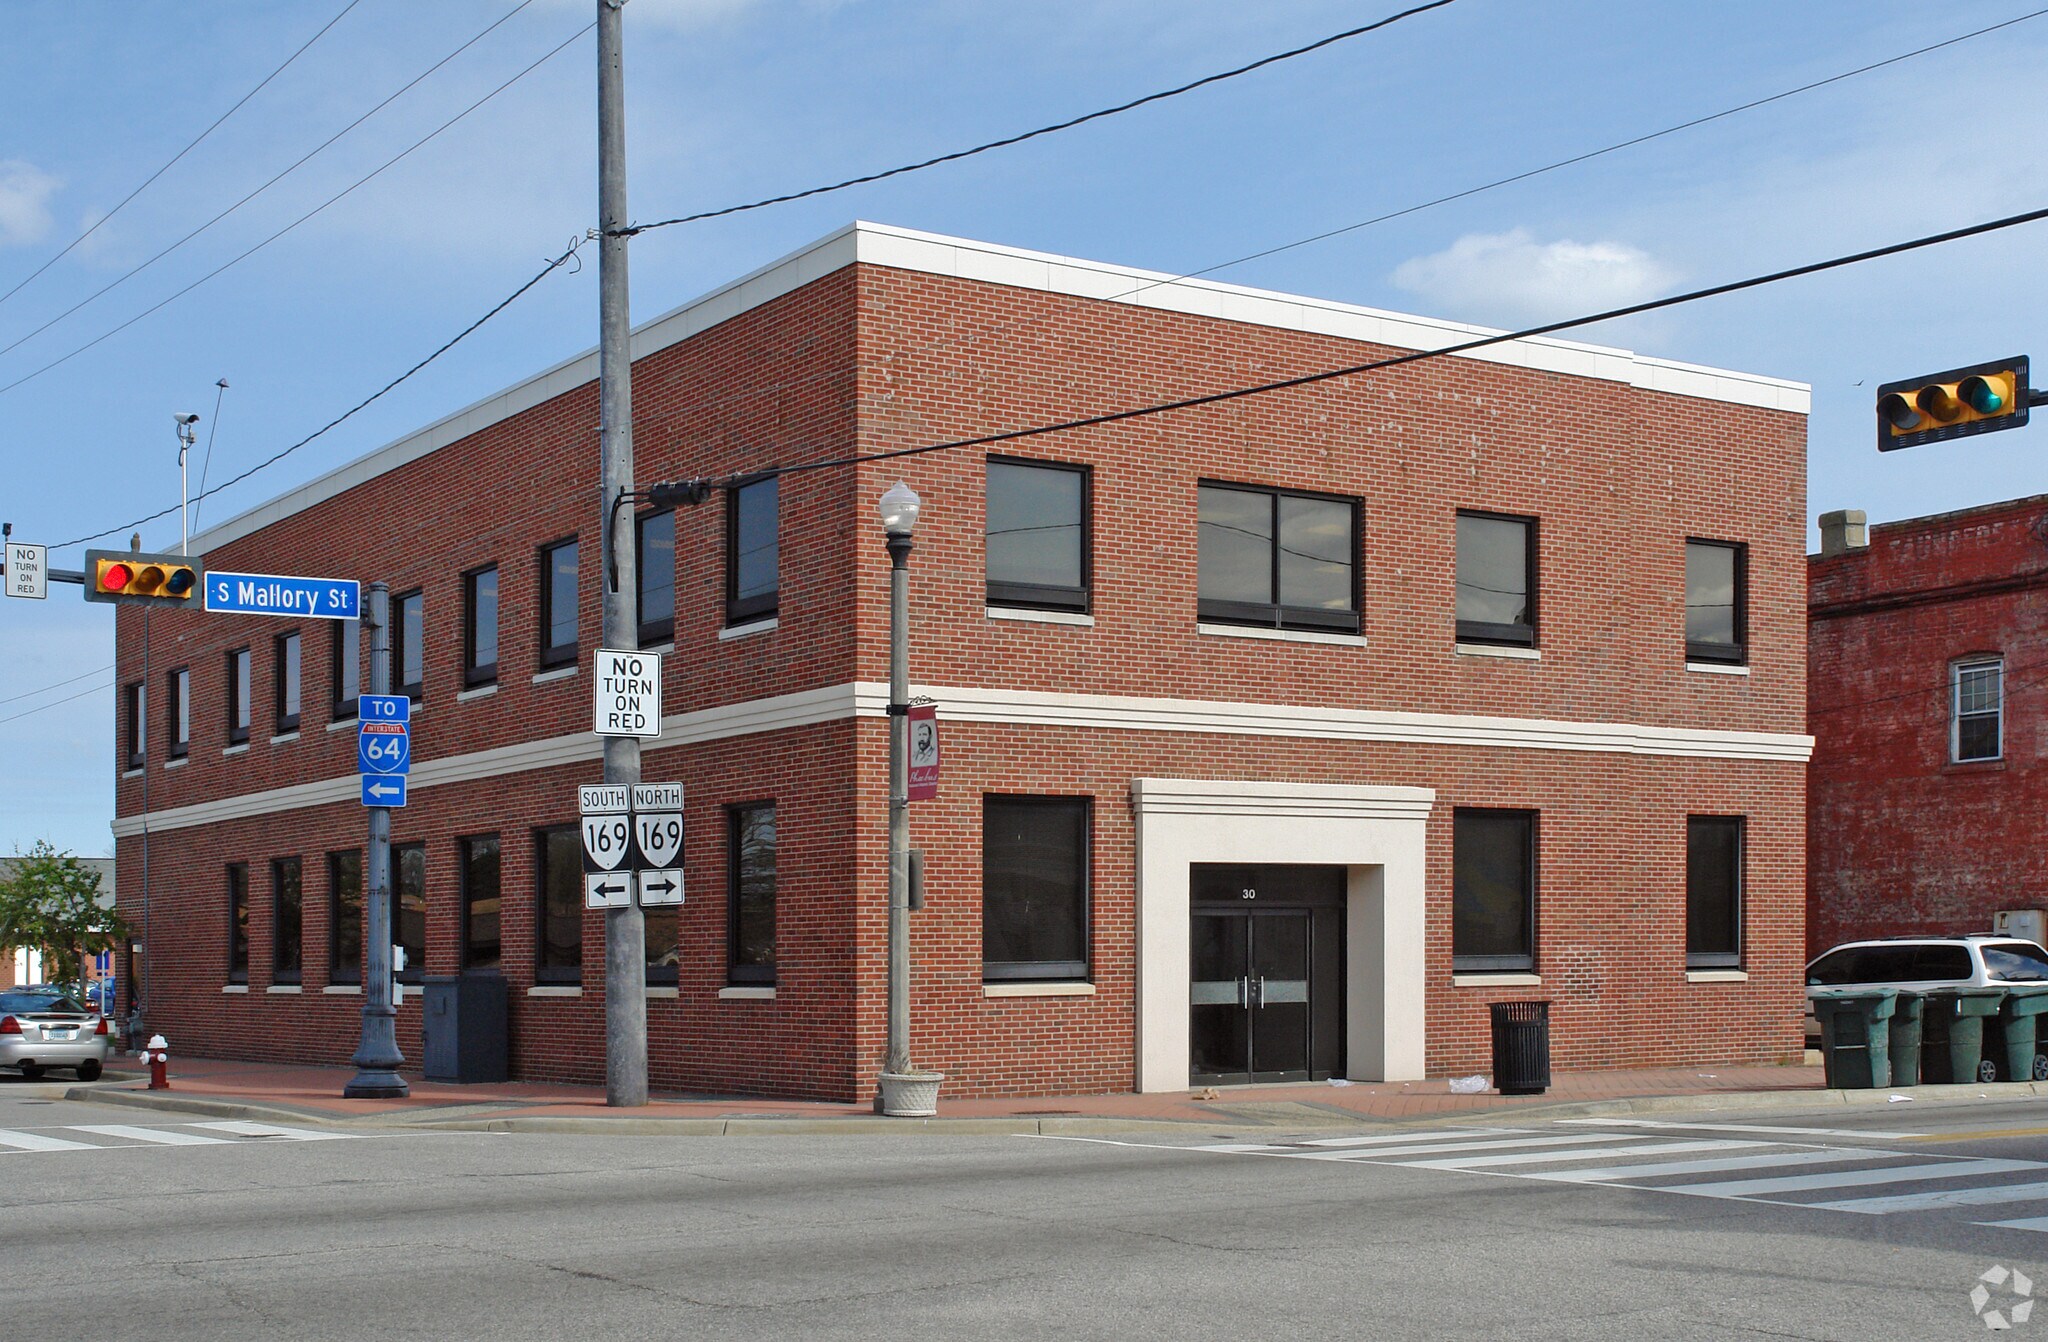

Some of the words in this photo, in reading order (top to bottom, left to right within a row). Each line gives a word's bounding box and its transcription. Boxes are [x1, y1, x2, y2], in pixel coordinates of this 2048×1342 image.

[16, 549, 36, 560] NO
[15, 562, 38, 571] TURN
[20, 574, 32, 582] ON
[17, 584, 35, 593] RED
[218, 582, 230, 602] S
[239, 581, 319, 615] Mallory
[329, 588, 348, 609] St
[613, 658, 643, 676] NO
[603, 677, 652, 695] TURN
[372, 701, 396, 716] TO
[615, 695, 640, 711] ON
[367, 725, 401, 733] INTERSTATE
[608, 713, 646, 729] RED
[367, 737, 401, 760] 64
[583, 791, 625, 807] SOUTH
[636, 789, 680, 805] NORTH
[588, 823, 627, 853] 169
[642, 821, 680, 851] 169
[1242, 888, 1256, 899] 30
